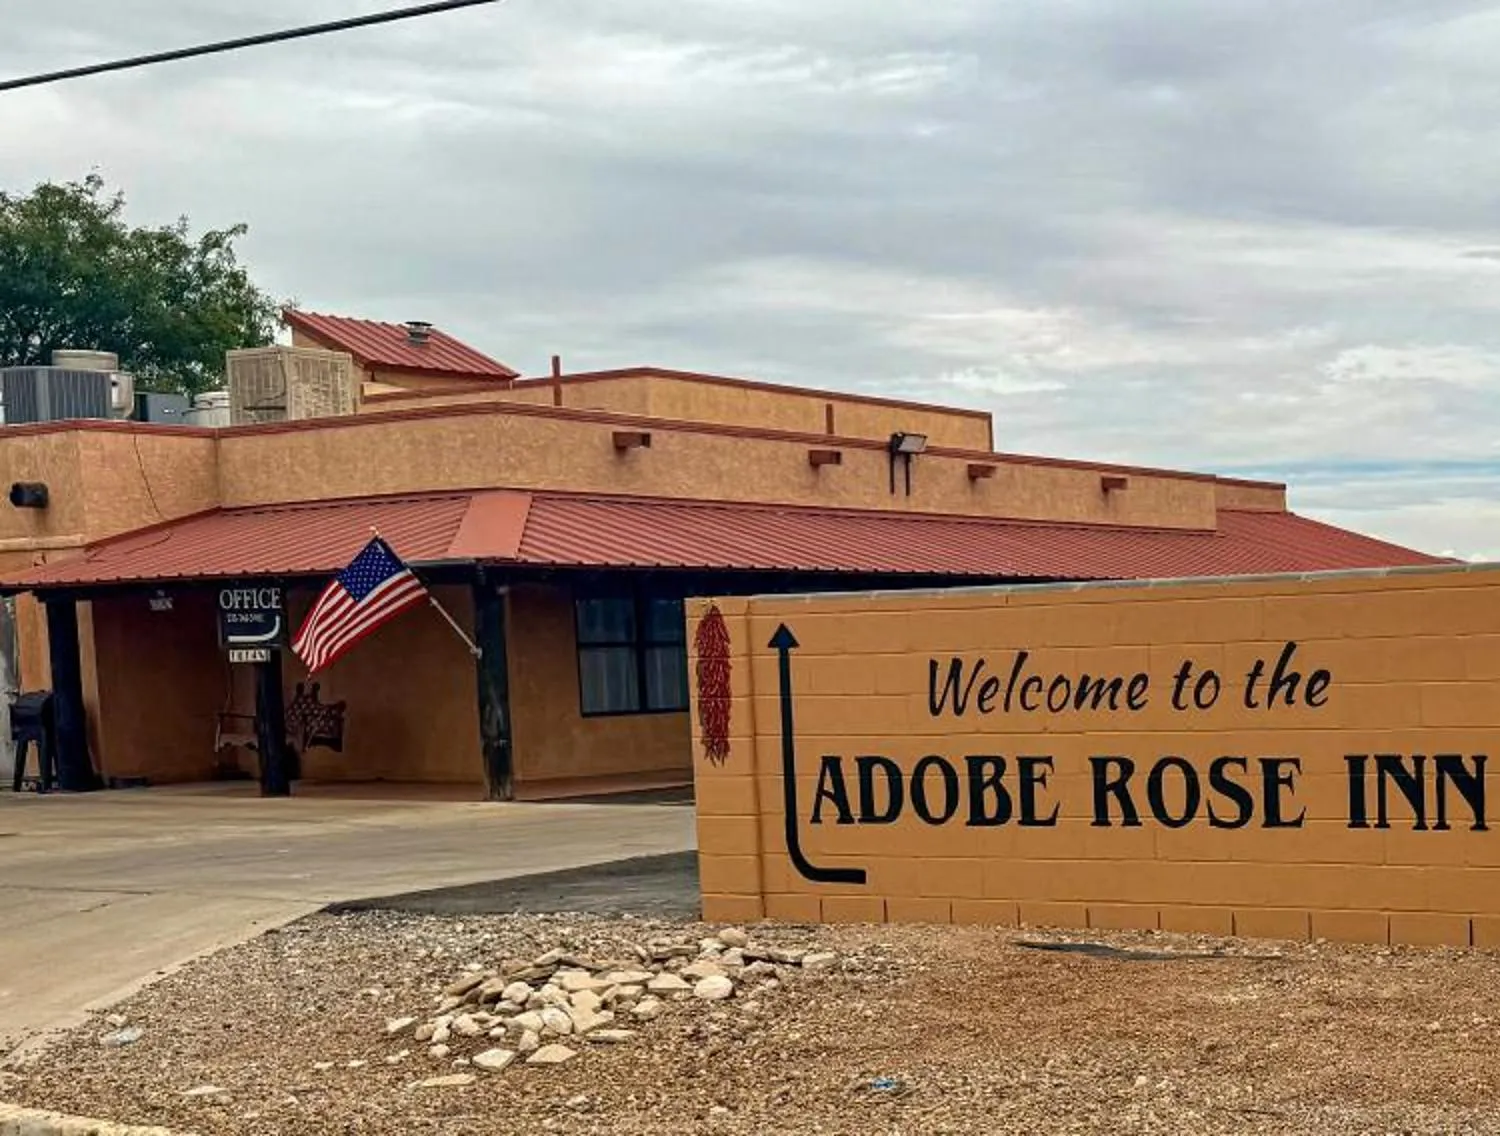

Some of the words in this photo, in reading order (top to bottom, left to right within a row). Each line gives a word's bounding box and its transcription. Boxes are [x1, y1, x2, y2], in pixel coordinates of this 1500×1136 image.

[219, 588, 282, 609] OFFICE
[928, 651, 1150, 717] Welcome
[1171, 658, 1221, 711] to
[1244, 640, 1332, 711] the
[809, 755, 1061, 827] ADOBE
[1087, 755, 1308, 830] ROSE
[1342, 753, 1490, 832] INN
